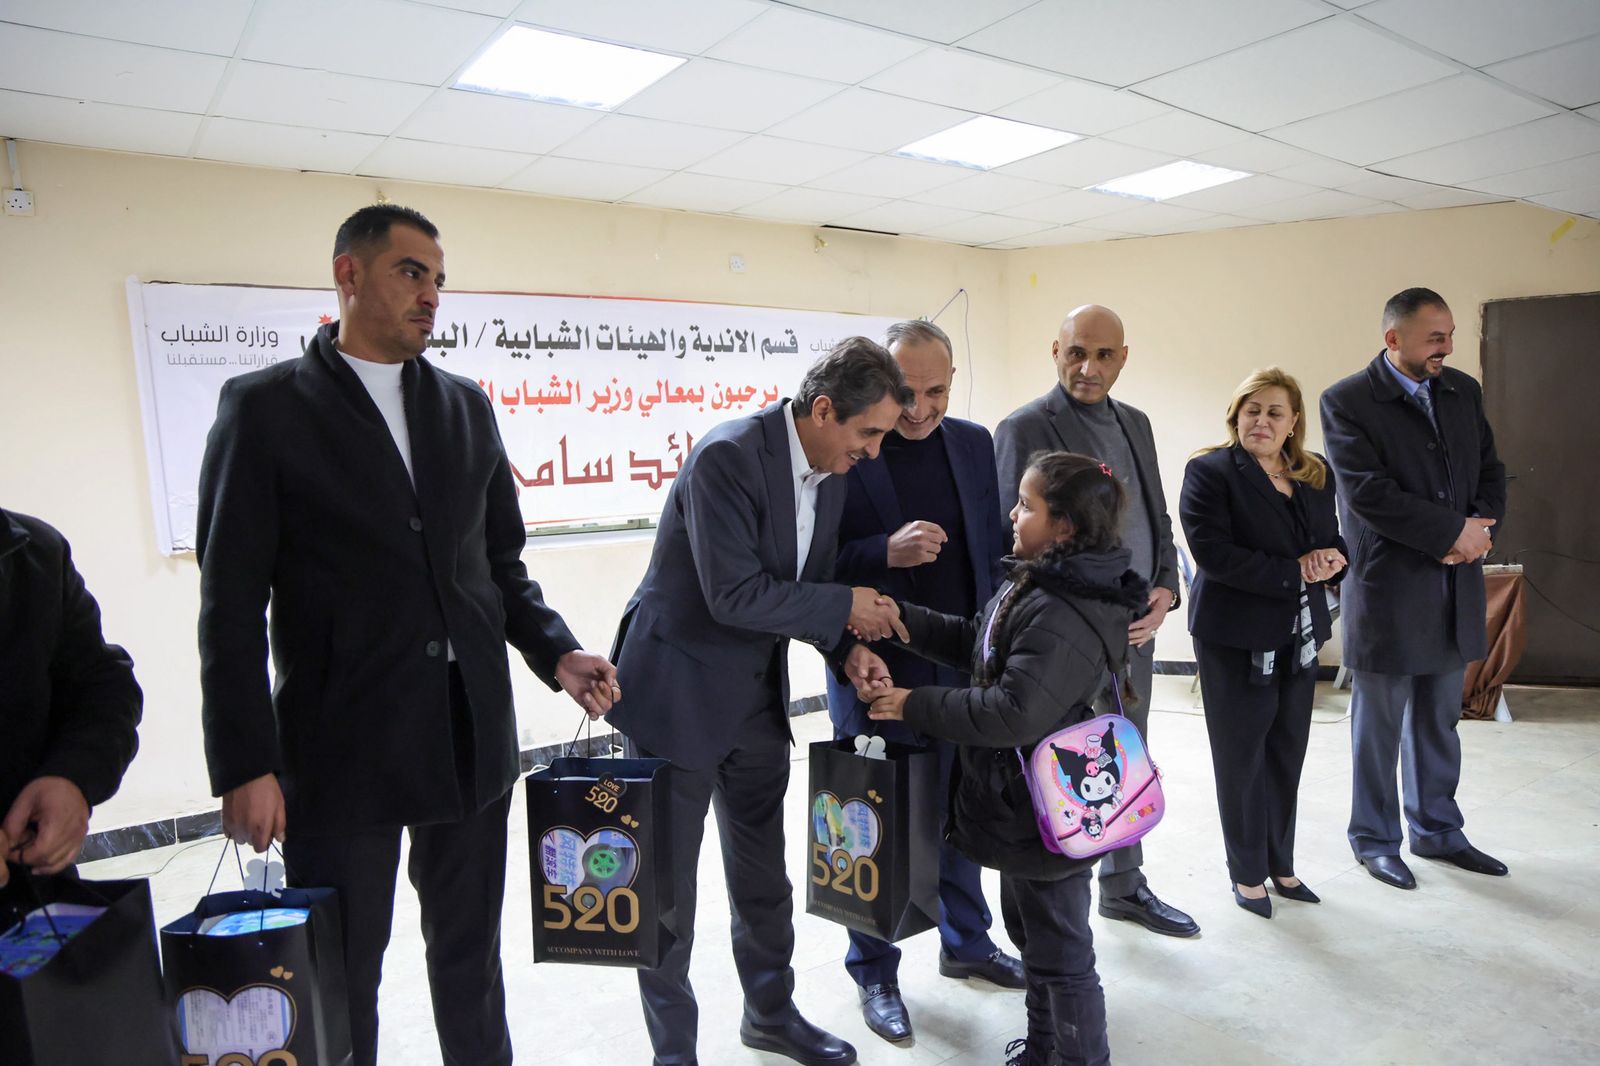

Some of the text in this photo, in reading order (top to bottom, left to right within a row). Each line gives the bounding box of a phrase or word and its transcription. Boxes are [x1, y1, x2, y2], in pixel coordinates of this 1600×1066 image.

[161, 322, 229, 346] الشباب
[236, 325, 279, 348] وزارة
[492, 318, 590, 361] الشبابية
[596, 323, 687, 360] والهيئات
[689, 325, 756, 362] الاندية
[761, 328, 799, 360] قسم
[501, 374, 581, 414] الشباب
[586, 376, 633, 415] وزير
[638, 378, 705, 417] بمعالي
[584, 785, 618, 813] 520
[603, 779, 621, 793] LOVE
[811, 842, 879, 902] 520
[543, 884, 640, 934] 520
